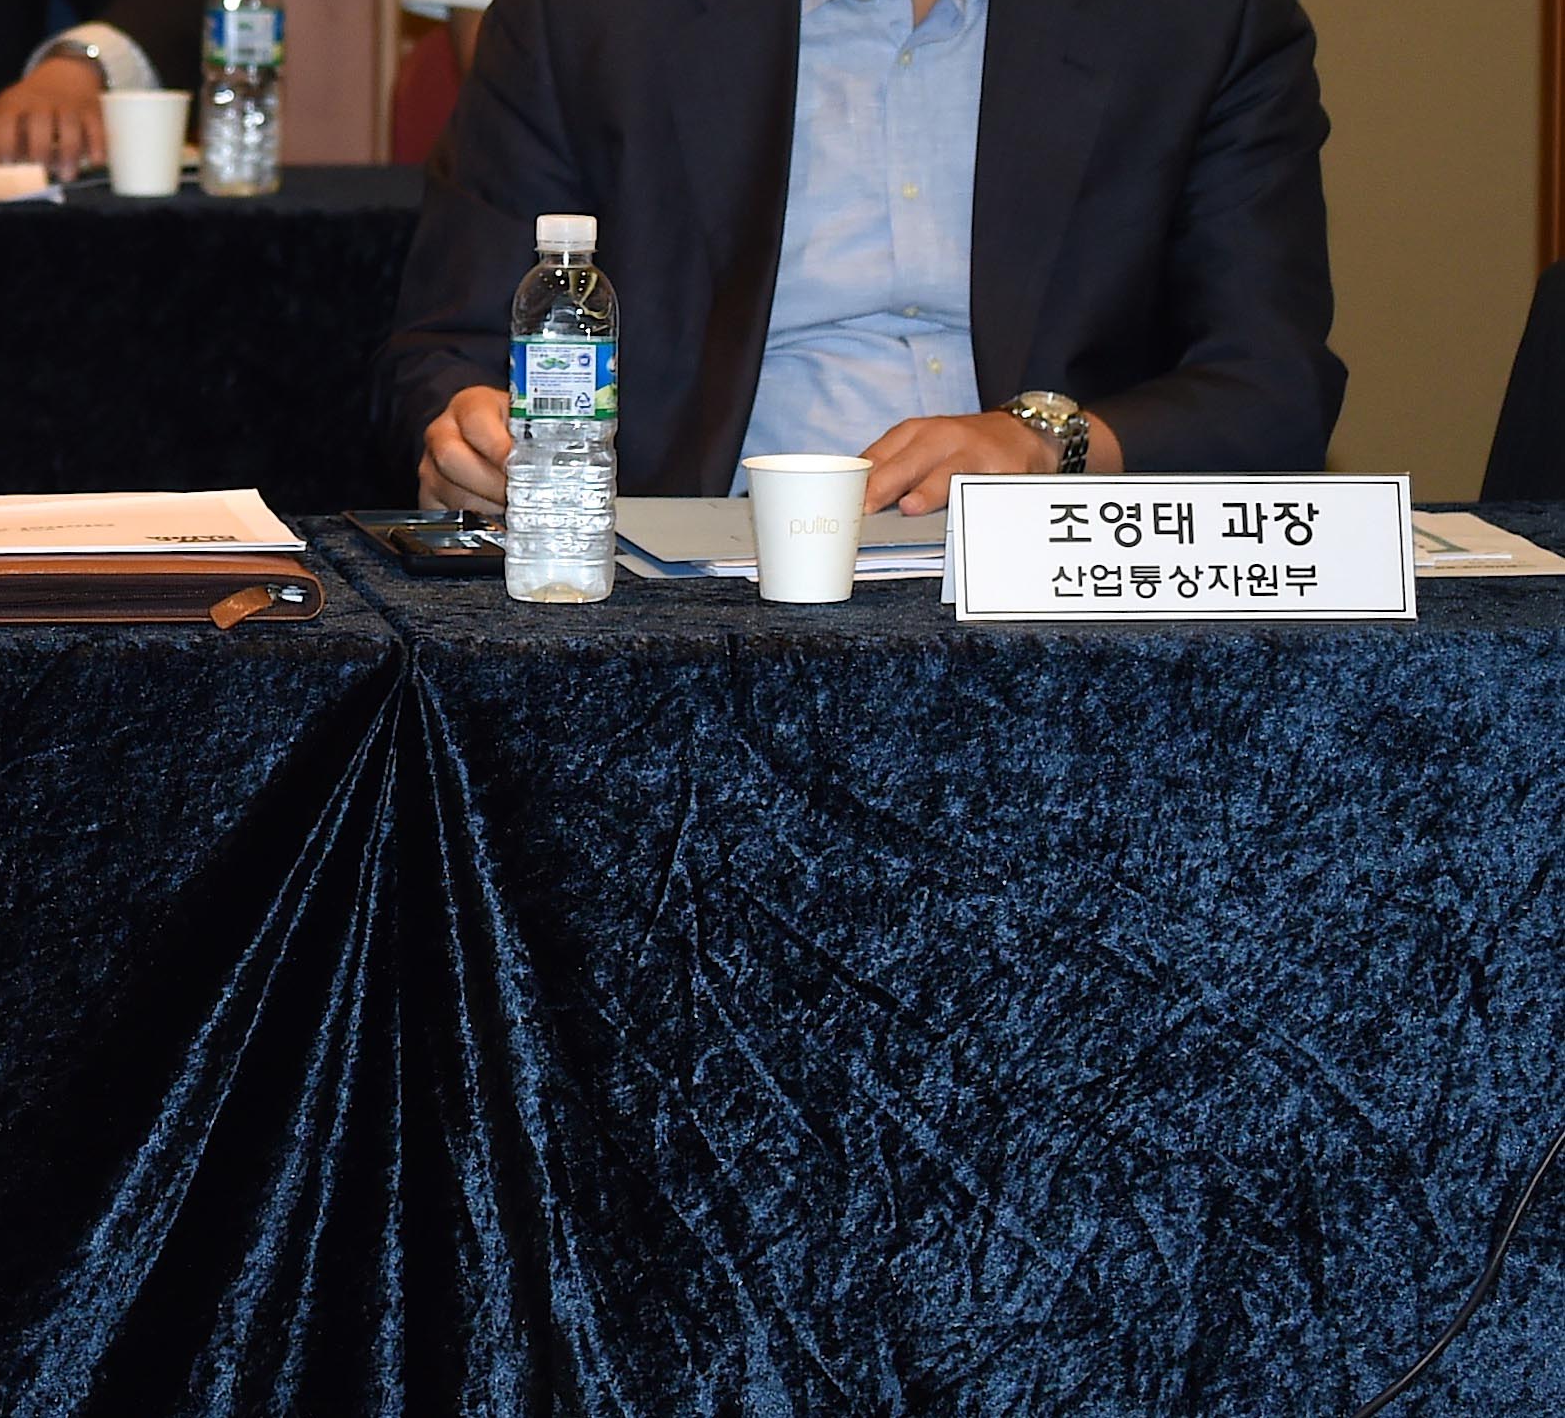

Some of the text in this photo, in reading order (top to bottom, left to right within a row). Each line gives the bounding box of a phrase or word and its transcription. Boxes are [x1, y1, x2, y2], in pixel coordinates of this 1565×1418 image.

[1049, 501, 1320, 548] 조영태 과장
[1051, 563, 1318, 599] 산업통상자원부
